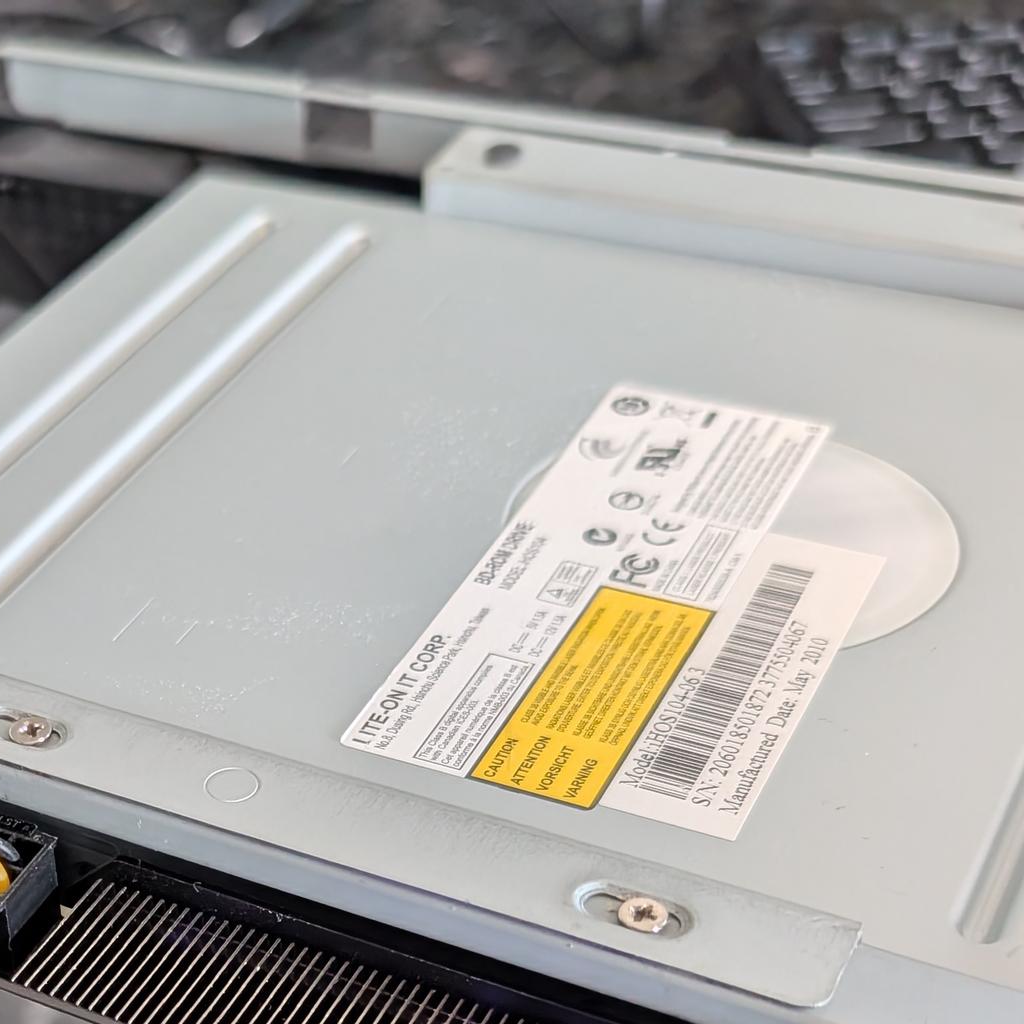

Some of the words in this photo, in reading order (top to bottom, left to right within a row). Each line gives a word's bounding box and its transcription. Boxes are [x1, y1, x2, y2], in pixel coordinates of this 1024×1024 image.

[472, 548, 514, 585] BD-ROM
[499, 521, 535, 550] DRIVE
[636, 518, 686, 548] CE
[407, 632, 452, 673] CORP.
[755, 619, 811, 688] 3775504067
[798, 636, 830, 665] 2010
[395, 673, 420, 688] IT
[782, 668, 817, 696] May
[351, 688, 408, 745] LITE-ON
[705, 687, 773, 777] 206018501872
[764, 695, 799, 728] Date:
[373, 733, 396, 750] No.8,
[482, 737, 518, 778] CAUTION
[509, 735, 551, 785] ATTENTION
[535, 745, 575, 792] VORSICHT
[562, 757, 598, 799] VARNING
[716, 730, 780, 815] Manufactured
[688, 776, 723, 807] S/N:
